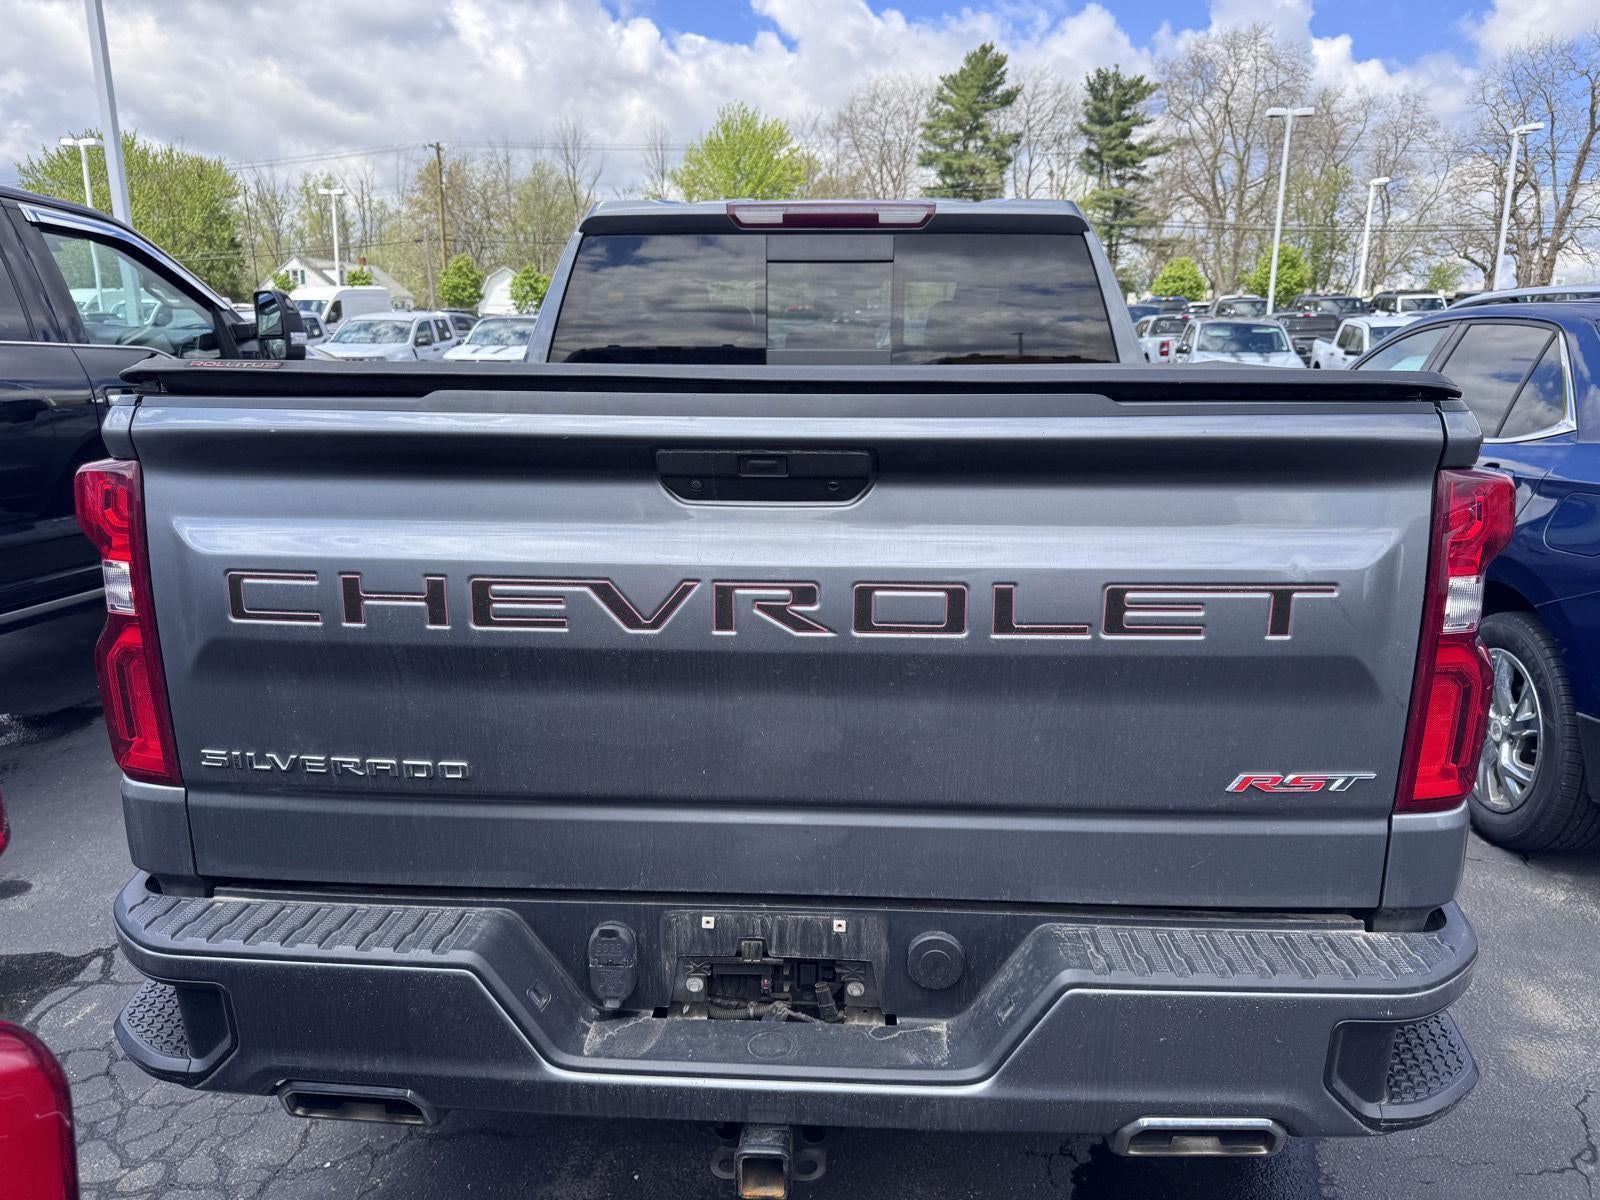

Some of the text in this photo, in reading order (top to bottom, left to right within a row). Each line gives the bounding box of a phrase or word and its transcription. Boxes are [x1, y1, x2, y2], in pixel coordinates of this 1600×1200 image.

[226, 570, 1339, 641] CHEVROLET
[200, 748, 470, 779] SILVERADO
[1225, 772, 1378, 793] RST
